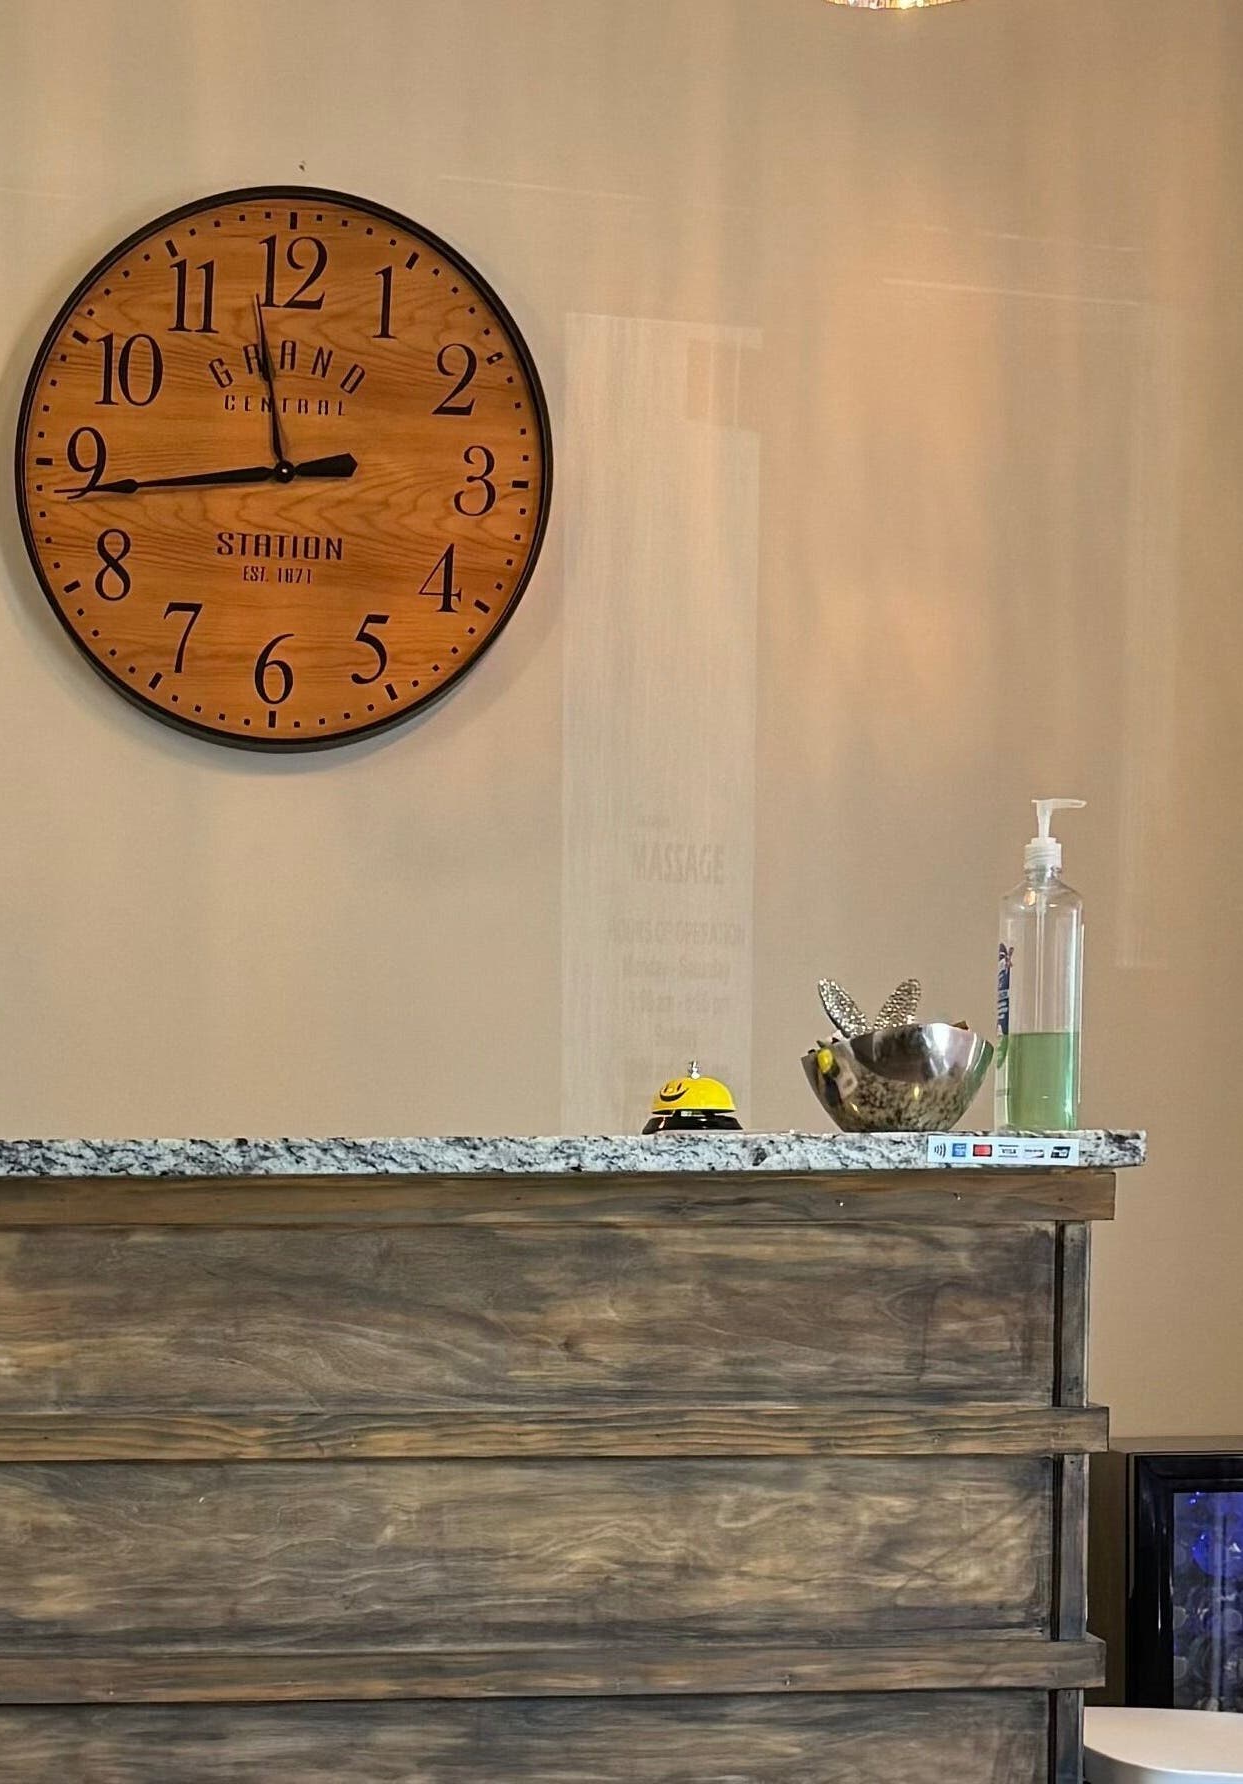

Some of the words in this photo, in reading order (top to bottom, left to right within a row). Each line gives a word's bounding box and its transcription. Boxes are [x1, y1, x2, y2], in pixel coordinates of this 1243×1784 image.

[168, 258, 219, 334] 11
[259, 234, 327, 310] 12
[372, 265, 398, 339] 1
[94, 333, 164, 407] 10
[209, 339, 367, 397] GRAND
[431, 343, 478, 416] 2
[223, 394, 347, 416] CENTRAL
[66, 426, 107, 500] 9
[453, 445, 497, 517] 3
[93, 528, 133, 602] 8
[216, 532, 344, 560] STATION
[418, 542, 464, 614] 4
[163, 601, 204, 674] 7
[253, 632, 295, 705] 6
[351, 613, 391, 685] 5
